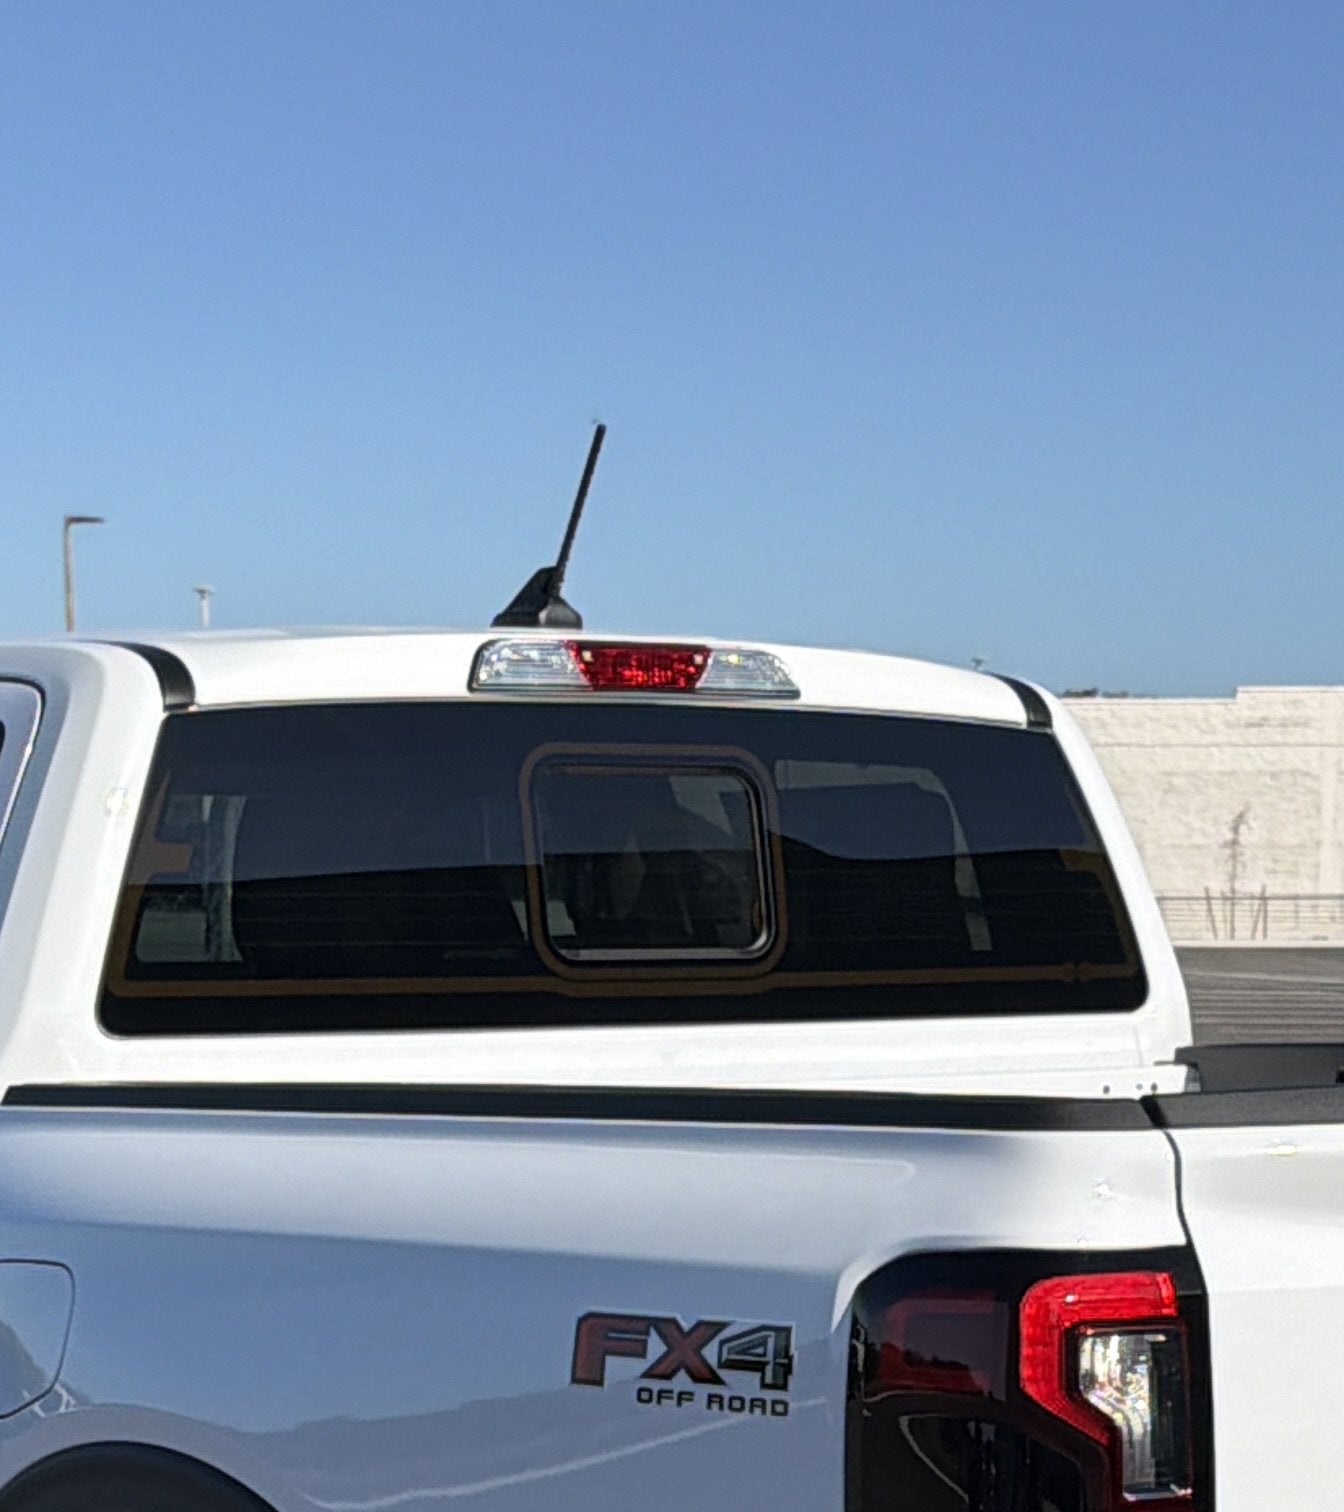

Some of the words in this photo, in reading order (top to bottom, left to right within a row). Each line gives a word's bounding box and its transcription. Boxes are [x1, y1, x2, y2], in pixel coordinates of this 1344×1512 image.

[570, 1310, 794, 1391] FX4
[636, 1386, 695, 1407] OFF
[707, 1392, 789, 1417] ROAD
